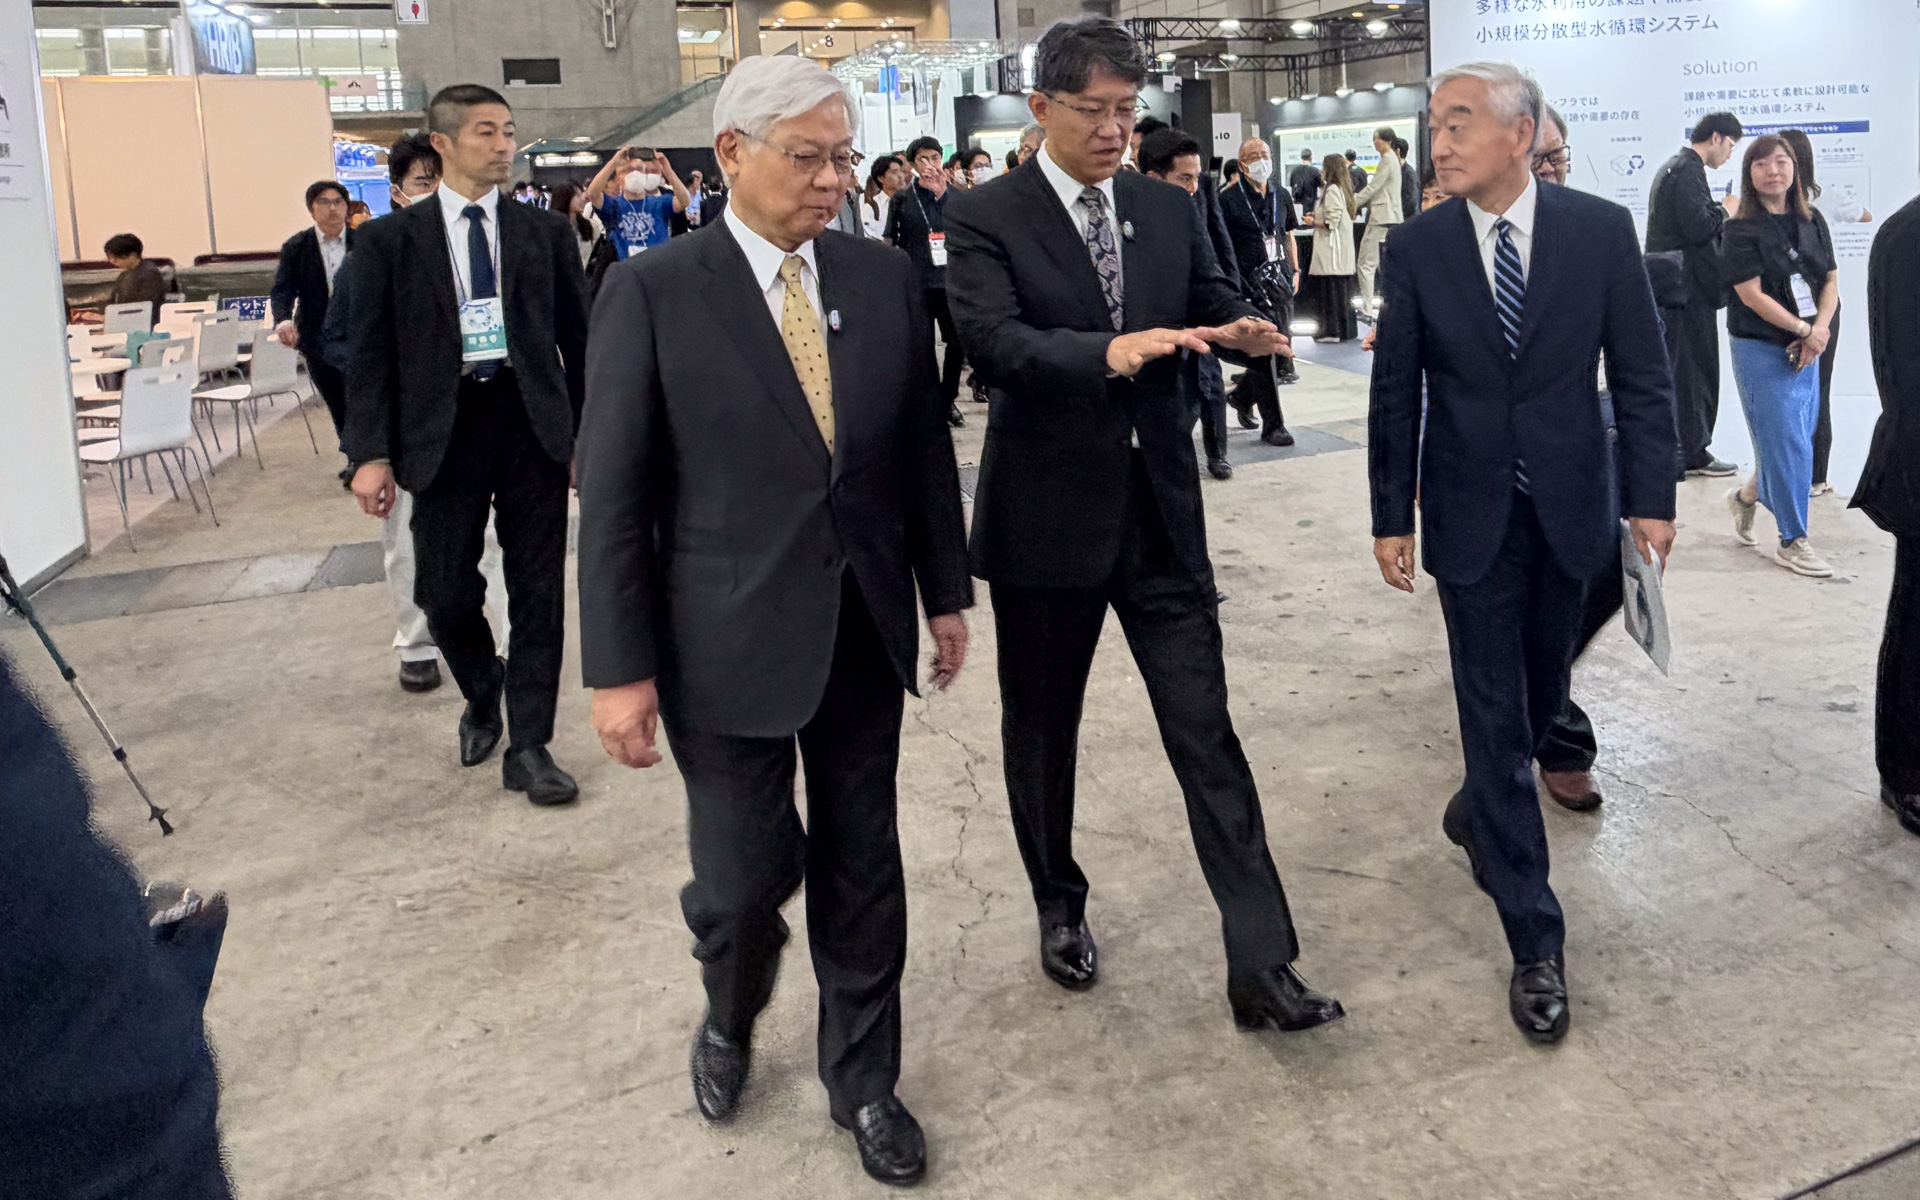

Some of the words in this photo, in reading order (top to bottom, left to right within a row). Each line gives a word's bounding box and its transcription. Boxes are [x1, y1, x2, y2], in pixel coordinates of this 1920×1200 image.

[1476, 14, 1719, 43] 小規模分散型水循環システム
[1683, 60, 1758, 76] solution
